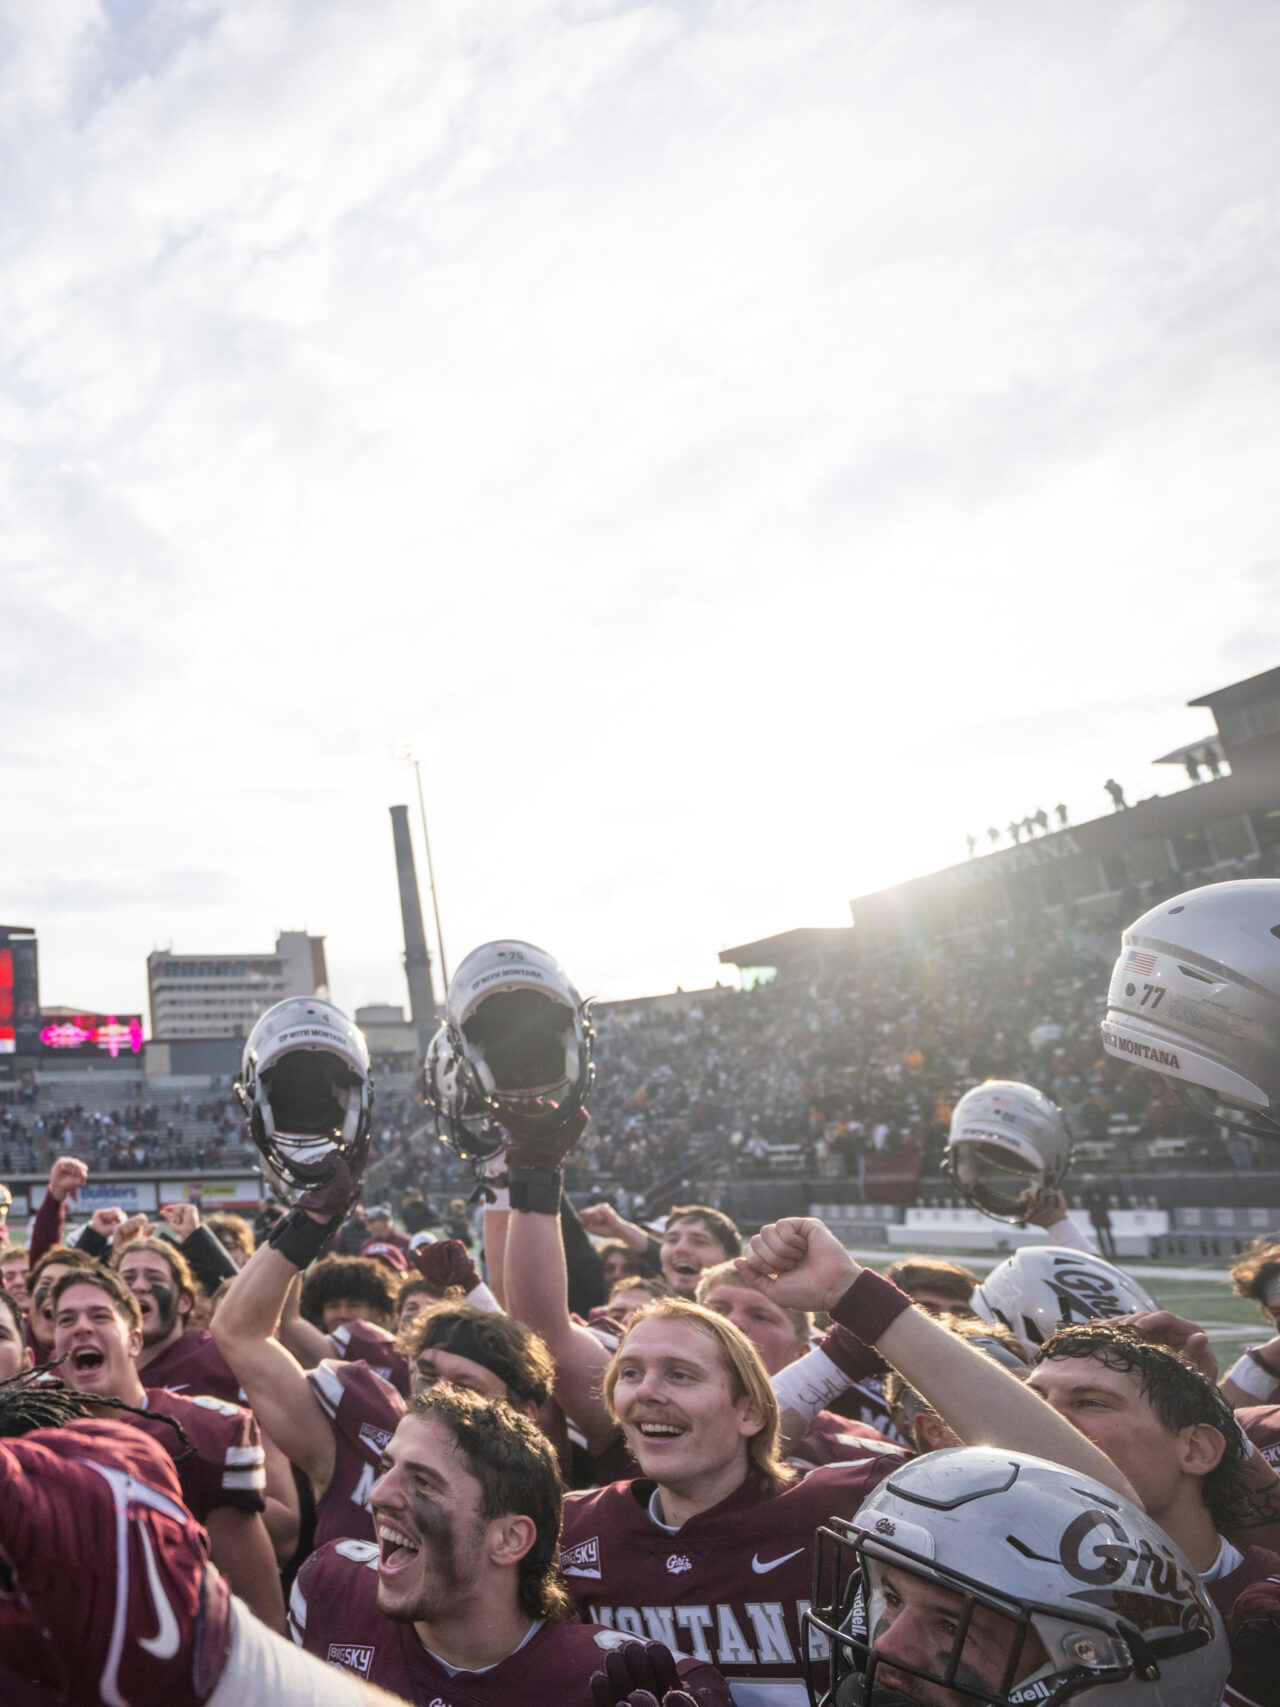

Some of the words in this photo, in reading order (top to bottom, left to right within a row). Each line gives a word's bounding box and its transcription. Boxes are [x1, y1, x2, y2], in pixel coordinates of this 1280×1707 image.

[502, 969, 543, 979] MONTANA
[1140, 983, 1167, 1008] 77
[311, 1029, 347, 1045] MONTANA
[1118, 1037, 1181, 1069] MONTANA
[875, 1517, 897, 1537] Griz
[666, 1554, 692, 1573] Griz
